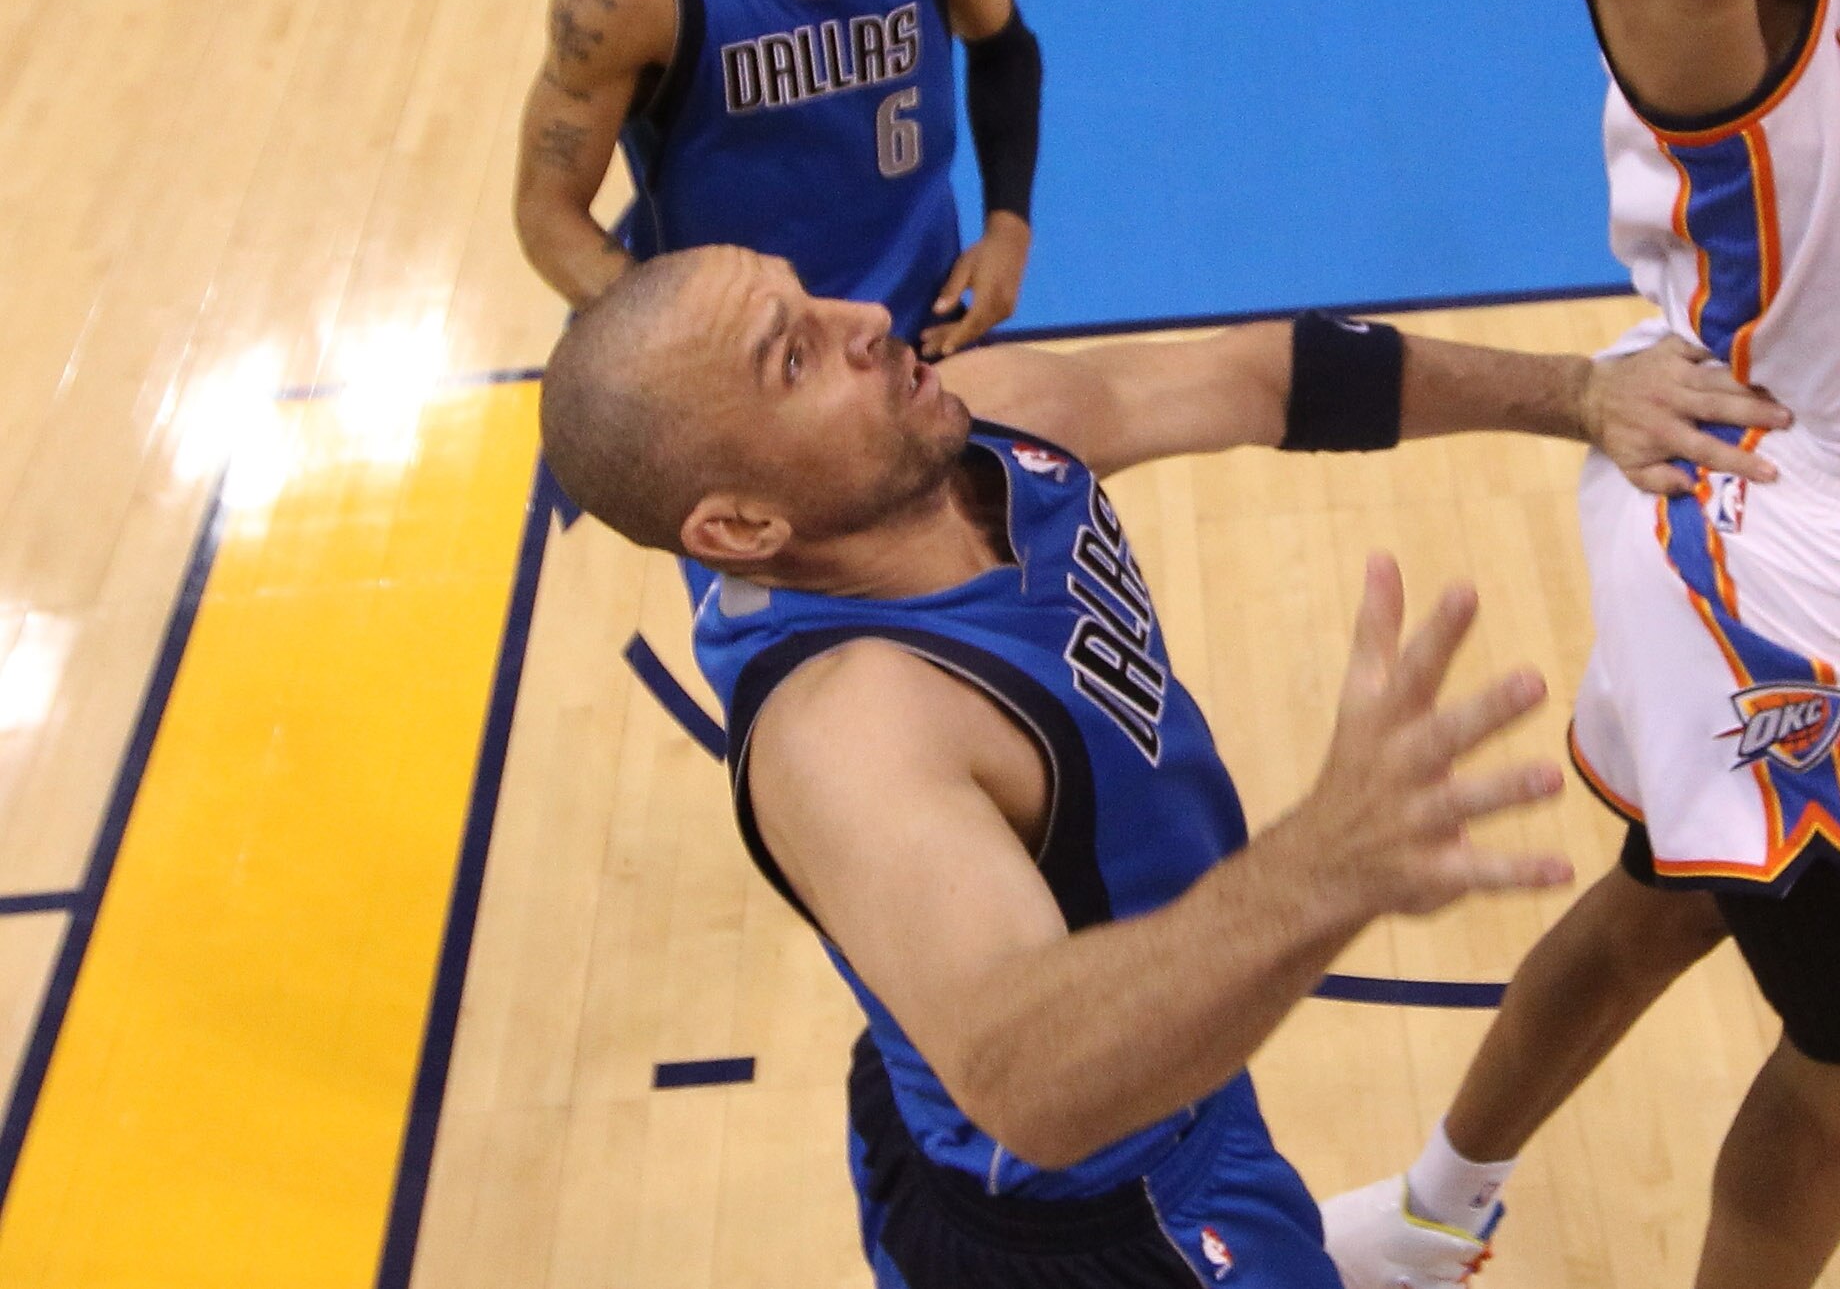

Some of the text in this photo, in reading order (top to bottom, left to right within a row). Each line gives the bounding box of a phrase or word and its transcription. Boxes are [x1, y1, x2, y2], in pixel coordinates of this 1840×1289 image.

[720, 2, 920, 113] DALLAS
[875, 86, 922, 179] 6
[1738, 698, 1824, 755] OKC
